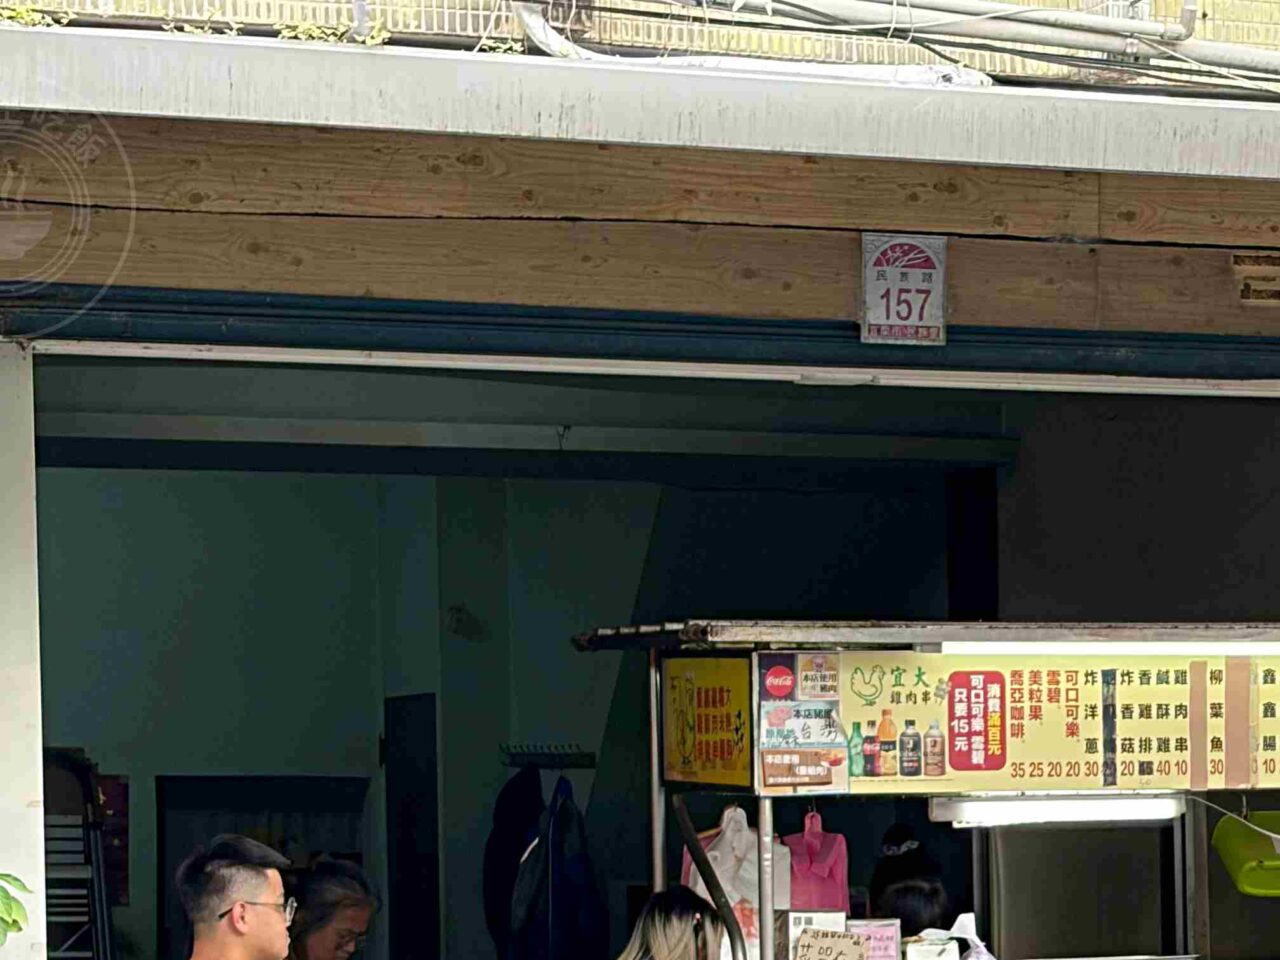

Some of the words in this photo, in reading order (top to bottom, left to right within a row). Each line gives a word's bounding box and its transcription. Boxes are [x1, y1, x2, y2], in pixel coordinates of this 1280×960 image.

[875, 271, 933, 284] 民族路
[880, 287, 932, 322] 157
[765, 674, 793, 687] Coca-Cola
[803, 673, 837, 683] 本店使用
[890, 666, 930, 688] 宜大
[1046, 669, 1061, 704] 雪碧
[890, 690, 932, 706] 雞肉串
[970, 674, 985, 732] 可口可樂
[1010, 669, 1025, 739] 喬亞咖啡
[1028, 669, 1043, 721] 美粒果
[1064, 669, 1080, 738] 可口可樂
[1262, 668, 1277, 752] 鑫鑫腸
[951, 688, 969, 751] 只要15元
[987, 683, 1002, 755] 消費滿百元
[1084, 669, 1099, 754] 炸洋蔥
[1120, 669, 1135, 754] 炸香菇
[1138, 669, 1153, 754] 香雞排
[1156, 669, 1171, 753] 鹹酥雞
[1174, 669, 1188, 753] 雞肉串
[1209, 669, 1224, 753] 柳葉魚
[971, 735, 985, 765] 雪碧
[1010, 762, 1025, 778] 35
[1028, 762, 1044, 778] 25
[1047, 761, 1062, 777] 20
[1065, 761, 1081, 777] 20
[1084, 761, 1099, 777] 30
[1120, 760, 1135, 776] 20
[1156, 760, 1171, 776] 40
[1174, 760, 1188, 775] 10
[1209, 759, 1224, 774] 30
[1262, 758, 1276, 773] 10
